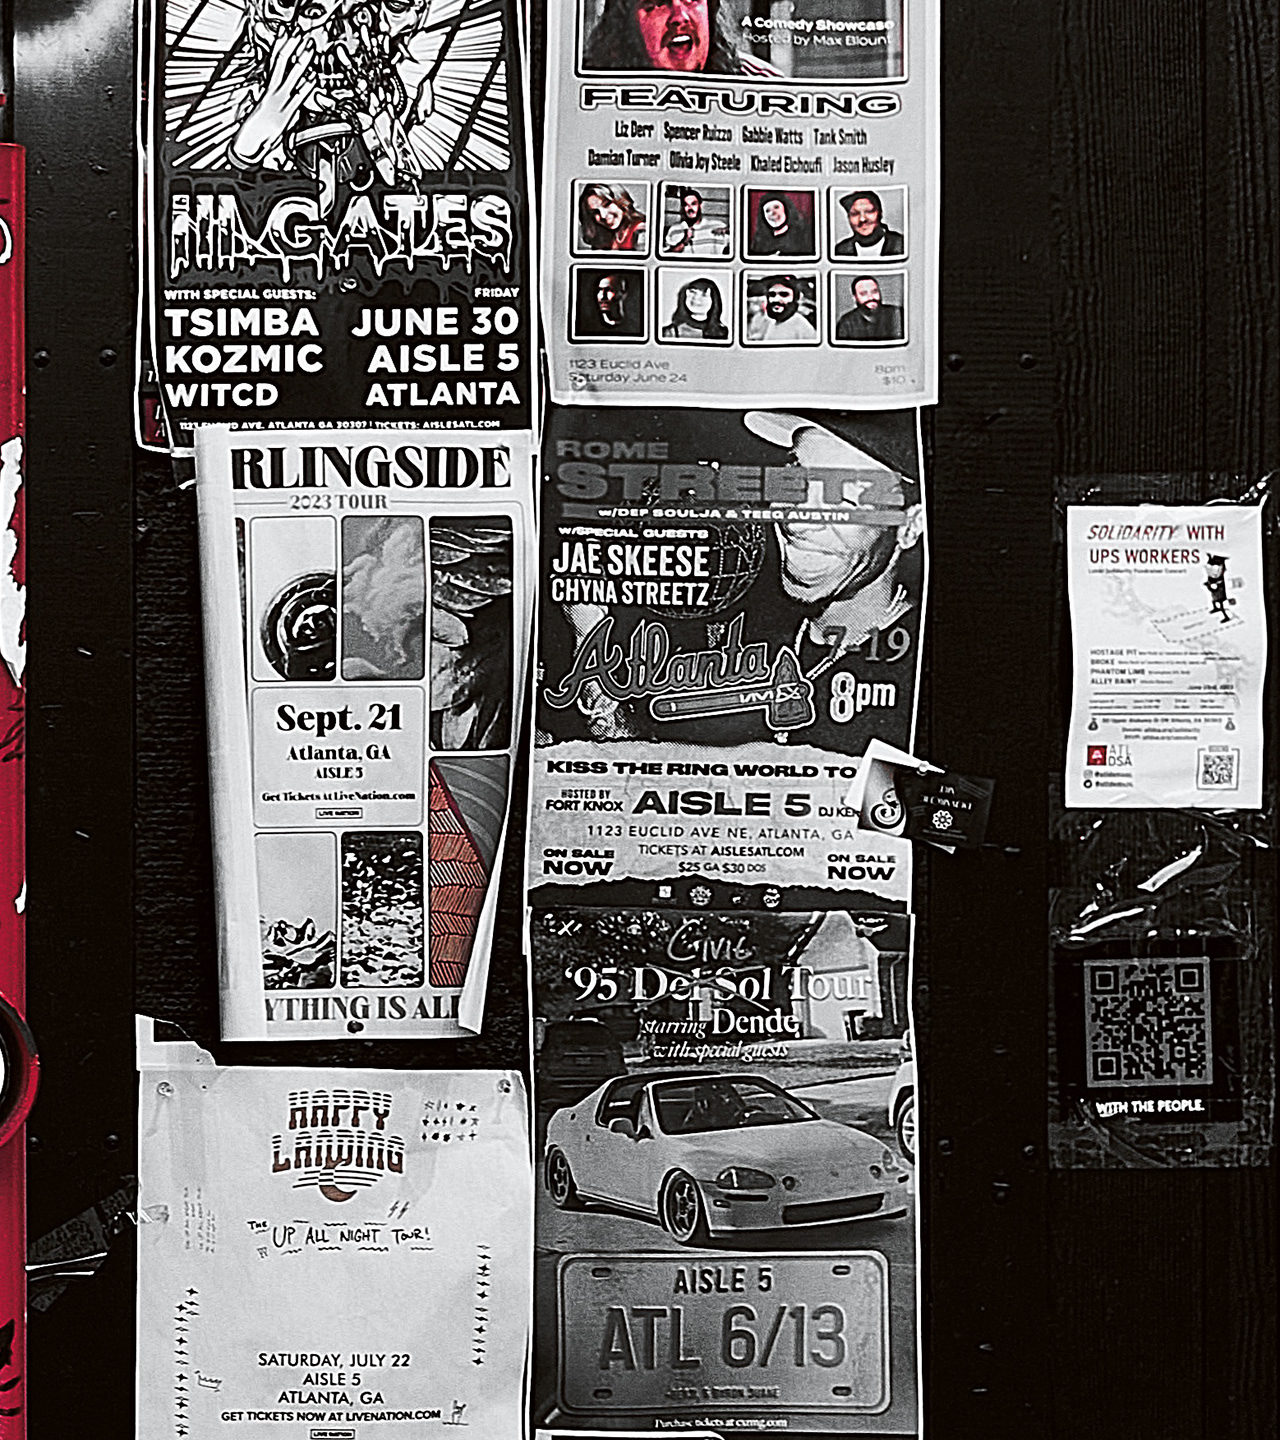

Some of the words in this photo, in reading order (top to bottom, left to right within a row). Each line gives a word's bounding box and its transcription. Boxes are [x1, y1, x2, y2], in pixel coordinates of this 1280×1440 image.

[741, 17, 752, 28] A
[754, 17, 813, 33] Comedy
[816, 18, 894, 32] Showcase
[793, 34, 810, 47] by
[813, 34, 842, 46] Max
[580, 84, 900, 117] FEATURING
[774, 127, 803, 145] Watts
[813, 128, 836, 146] Tank
[838, 129, 867, 146] Smith
[164, 288, 200, 301] WITH
[203, 288, 260, 301] SPECIAL
[262, 287, 318, 301] GUESTS:
[474, 286, 520, 299] FRIDAY
[163, 307, 320, 337] TSIMBA
[351, 306, 460, 337] JUNE
[471, 306, 520, 336] 30
[164, 343, 324, 374] KOZMIC
[366, 343, 485, 374] AISLE
[496, 342, 520, 373] 5
[643, 359, 670, 371] Ave
[631, 372, 666, 385] June
[668, 373, 688, 384] 24
[163, 382, 279, 407] WITCD
[365, 380, 521, 407] ATLANTA
[555, 439, 669, 460] ROME
[555, 461, 906, 507] STREETZ
[289, 494, 333, 511] 2023
[334, 493, 389, 510] TOUR
[652, 507, 722, 519] SOULJA
[725, 508, 739, 520] &
[786, 510, 850, 522] AUSTIN
[1087, 524, 1180, 542] SOLIDARITY
[1186, 524, 1225, 541] WITH
[552, 540, 603, 575] JAE
[607, 544, 710, 578] SKEESE
[1089, 548, 1120, 565] UPS
[1124, 548, 1201, 565] WORKERS
[551, 578, 619, 605] CHYNA
[621, 582, 710, 607] STREETZ
[545, 612, 770, 709] Atlanta
[829, 671, 897, 723] 8pm
[276, 704, 362, 737] Sept.
[368, 703, 403, 731] 21
[286, 745, 364, 762] Atlanta,
[366, 744, 391, 760] GA
[315, 767, 353, 780] AISLE
[546, 760, 609, 774] KISS
[612, 761, 663, 775] THE
[666, 763, 730, 778] RING
[733, 763, 820, 779] WORLD
[545, 799, 580, 812] FORT
[582, 799, 623, 812] KNOX
[630, 790, 772, 817] AISLE
[783, 792, 813, 817] 5
[587, 825, 623, 837] 1123
[628, 825, 686, 839] EUCLID
[688, 826, 720, 839] AVE
[726, 826, 754, 841] NE,
[756, 827, 827, 842] ATLANTA,
[831, 829, 854, 841] GA
[543, 848, 568, 859] ON
[571, 848, 615, 859] SALE
[542, 860, 615, 876] NOW
[826, 865, 896, 881] NOW
[715, 964, 771, 1001] Sol
[781, 965, 873, 1001] Tour
[377, 995, 407, 1020] IS
[641, 1019, 708, 1040] starring
[712, 1007, 801, 1038] Dende
[1131, 1101, 1155, 1113] THE
[272, 1225, 298, 1249] UP
[303, 1227, 331, 1244] ALL
[339, 1227, 382, 1244] NIGHT
[673, 1267, 747, 1295] AISLE
[757, 1266, 773, 1292] 5
[598, 1305, 702, 1372] ATL
[719, 1303, 849, 1370] 6/13
[257, 1352, 343, 1369] SATURDAY,
[349, 1353, 386, 1368] JULY
[391, 1353, 411, 1368] 22
[302, 1373, 347, 1387] AISLE
[351, 1373, 361, 1386] 5
[277, 1390, 354, 1406] ATLANTA,
[359, 1391, 384, 1405] GA
[220, 1411, 244, 1422] GET
[246, 1410, 295, 1422] TICKETS
[297, 1411, 326, 1422] NOW
[345, 1409, 441, 1422] LIVENATION.COM
